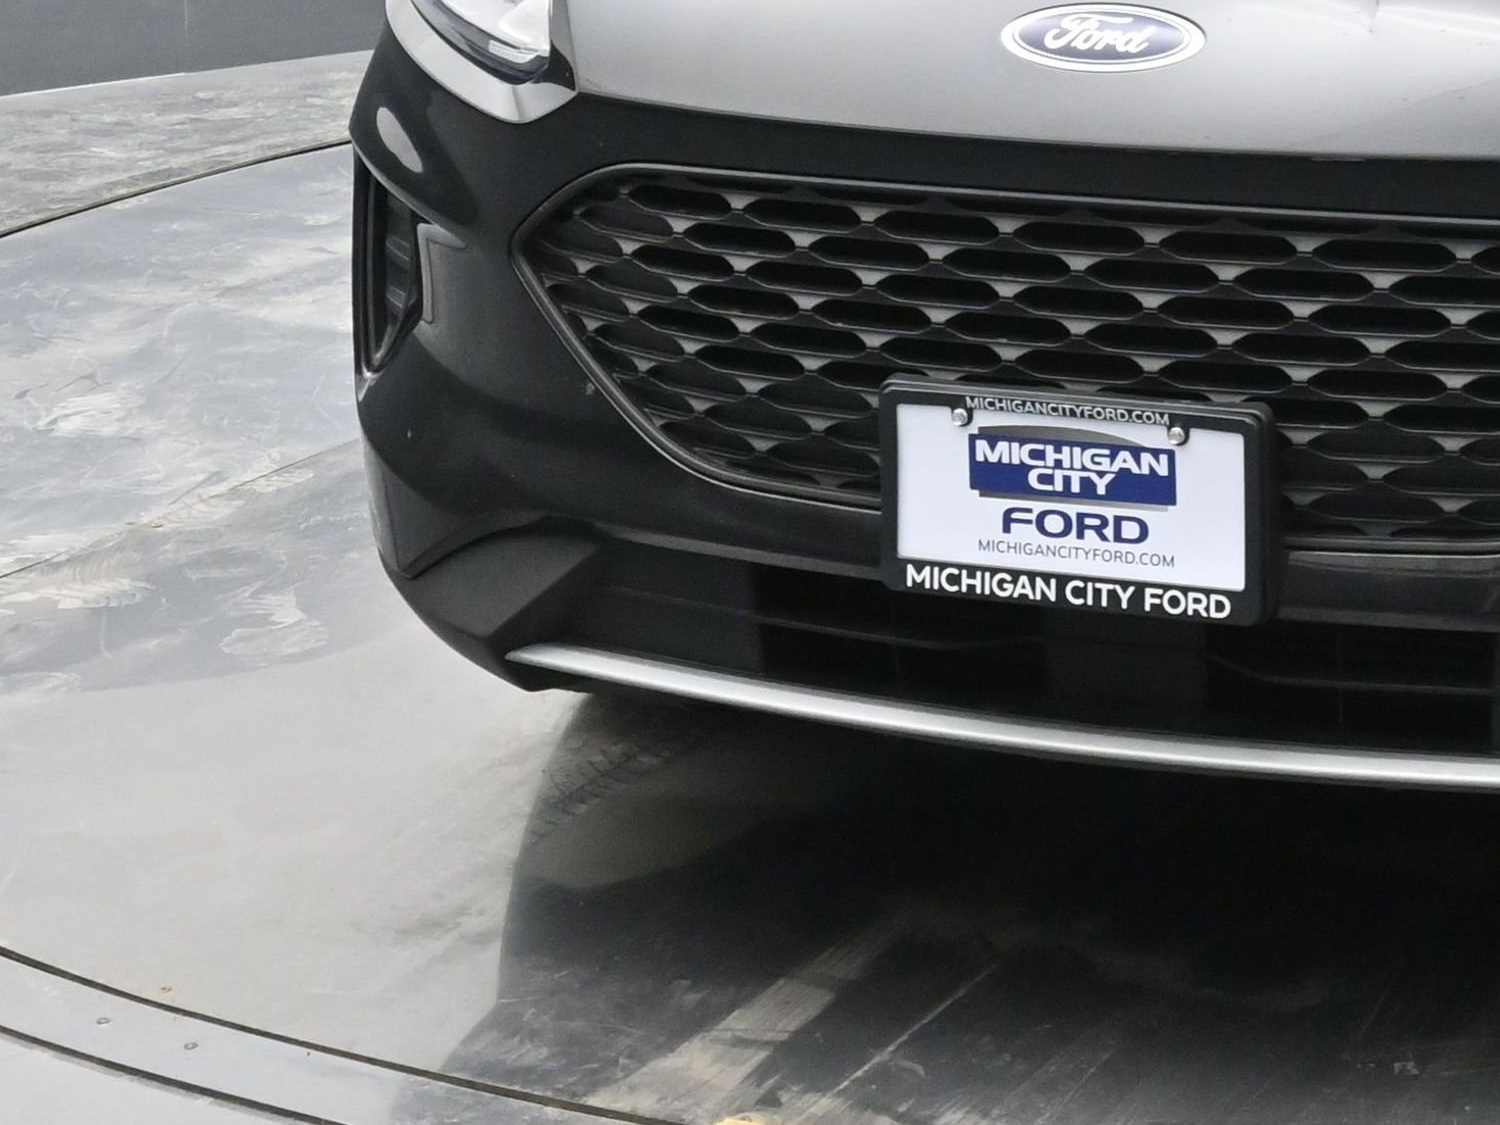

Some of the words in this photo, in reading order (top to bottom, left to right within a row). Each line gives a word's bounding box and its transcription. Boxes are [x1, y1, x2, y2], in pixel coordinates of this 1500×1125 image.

[1044, 13, 1156, 53] Ford
[966, 396, 1170, 425] MICHIGANCITYFORD.COM
[975, 440, 1168, 476] MICHIGAN
[1028, 468, 1117, 495] CITY
[1002, 507, 1150, 544] FORD
[978, 539, 1175, 567] MICHIGANCITYFORD.COM
[906, 564, 1057, 602] MICHIGAN
[1065, 580, 1136, 609] CITY
[1144, 588, 1231, 619] FORD
